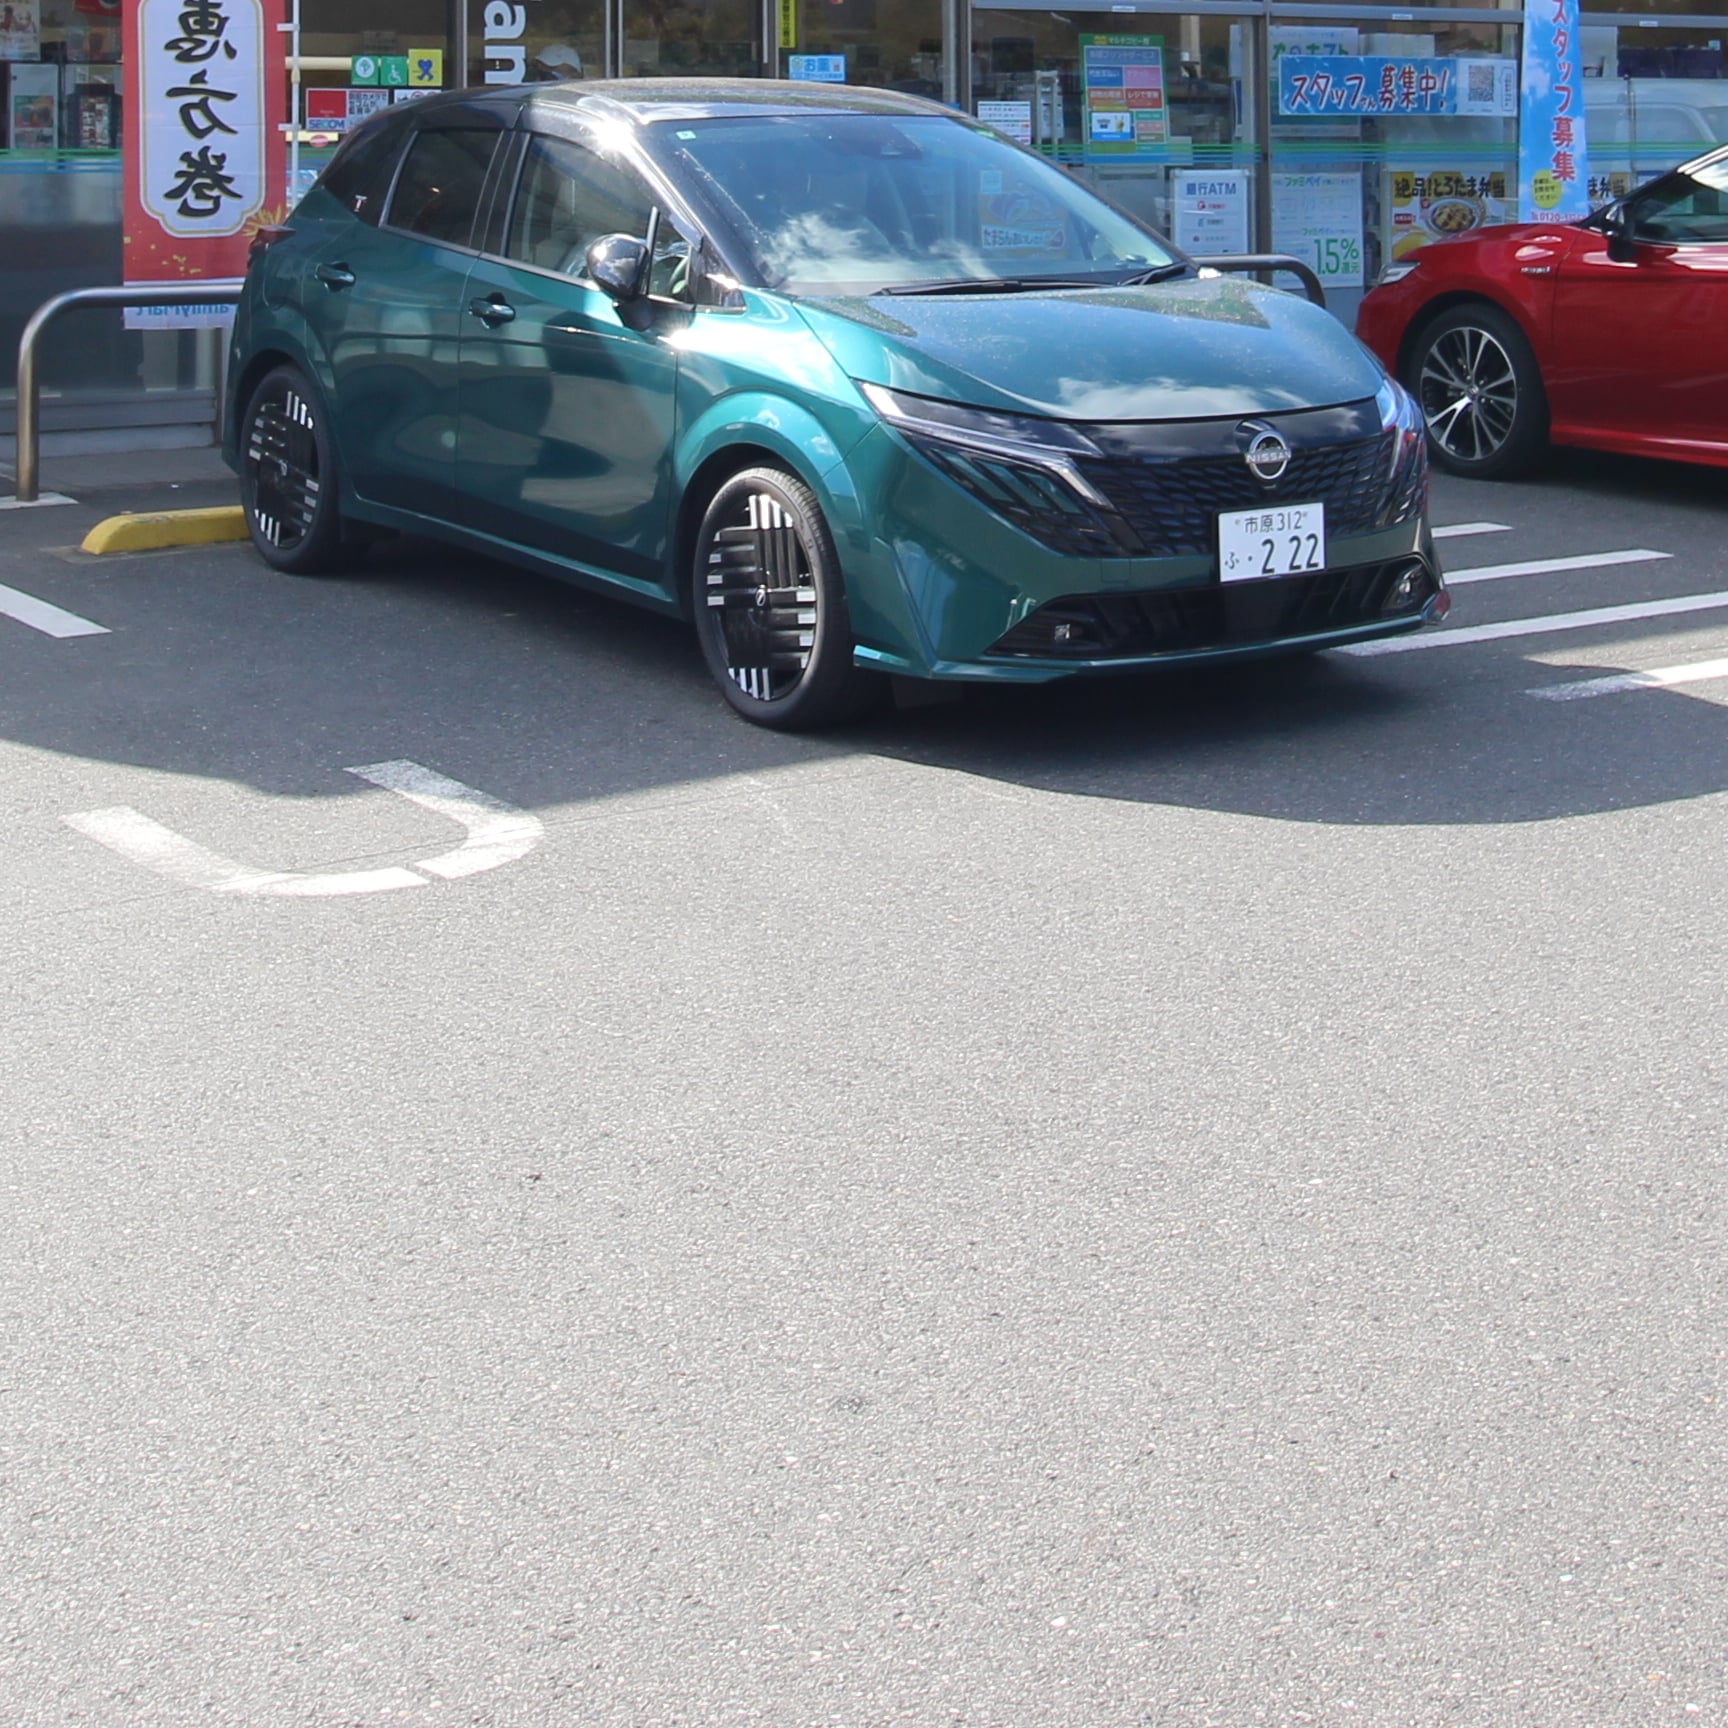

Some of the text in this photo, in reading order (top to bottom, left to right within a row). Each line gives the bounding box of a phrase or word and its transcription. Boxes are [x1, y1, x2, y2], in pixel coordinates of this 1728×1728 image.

[308, 118, 345, 130] SECOM
[1186, 182, 1237, 196] 銀行ATM
[1246, 449, 1291, 463] NISSAN
